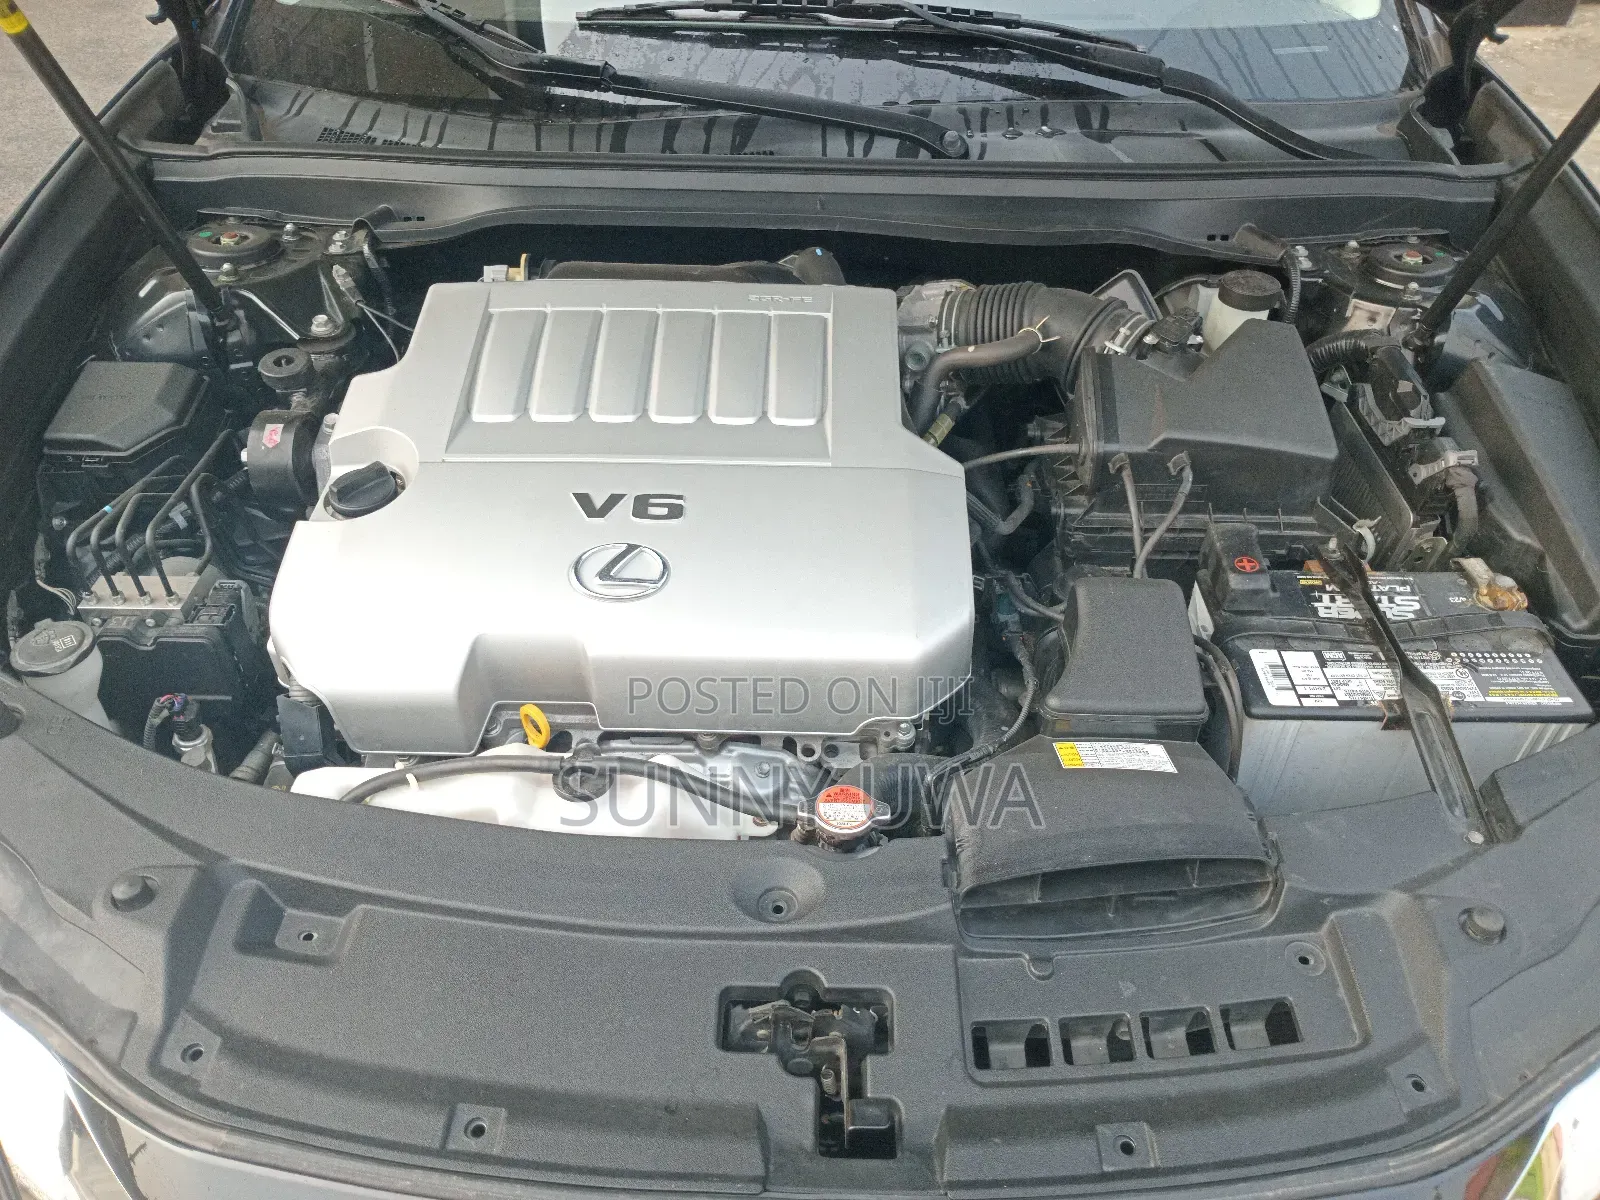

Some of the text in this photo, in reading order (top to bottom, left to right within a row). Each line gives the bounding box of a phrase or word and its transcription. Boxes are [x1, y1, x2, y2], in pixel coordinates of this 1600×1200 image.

[570, 492, 684, 520] V6
[1325, 584, 1411, 593] PLATM
[1310, 594, 1421, 611] STRT
